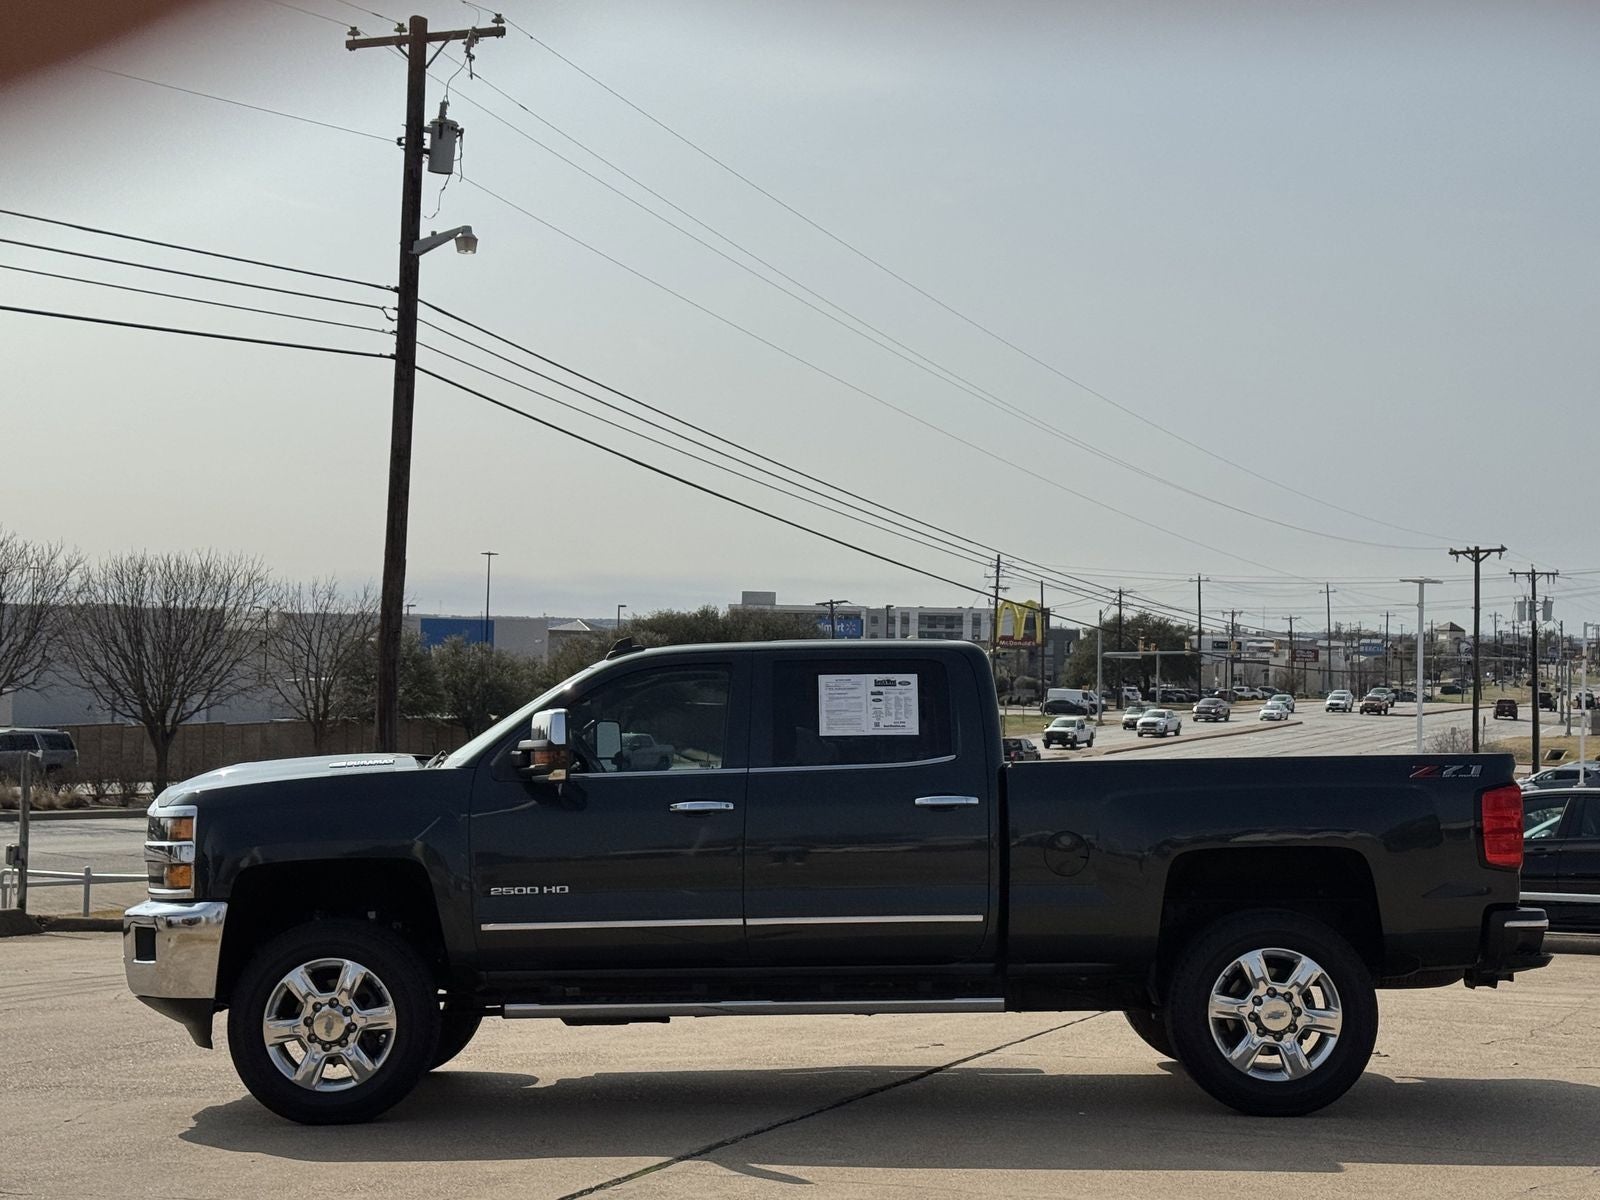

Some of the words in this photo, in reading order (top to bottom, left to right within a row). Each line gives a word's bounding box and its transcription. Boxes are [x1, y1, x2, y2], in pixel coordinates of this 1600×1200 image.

[1409, 765, 1482, 778] Z71
[490, 886, 539, 895] 2500
[543, 885, 569, 894] HD
